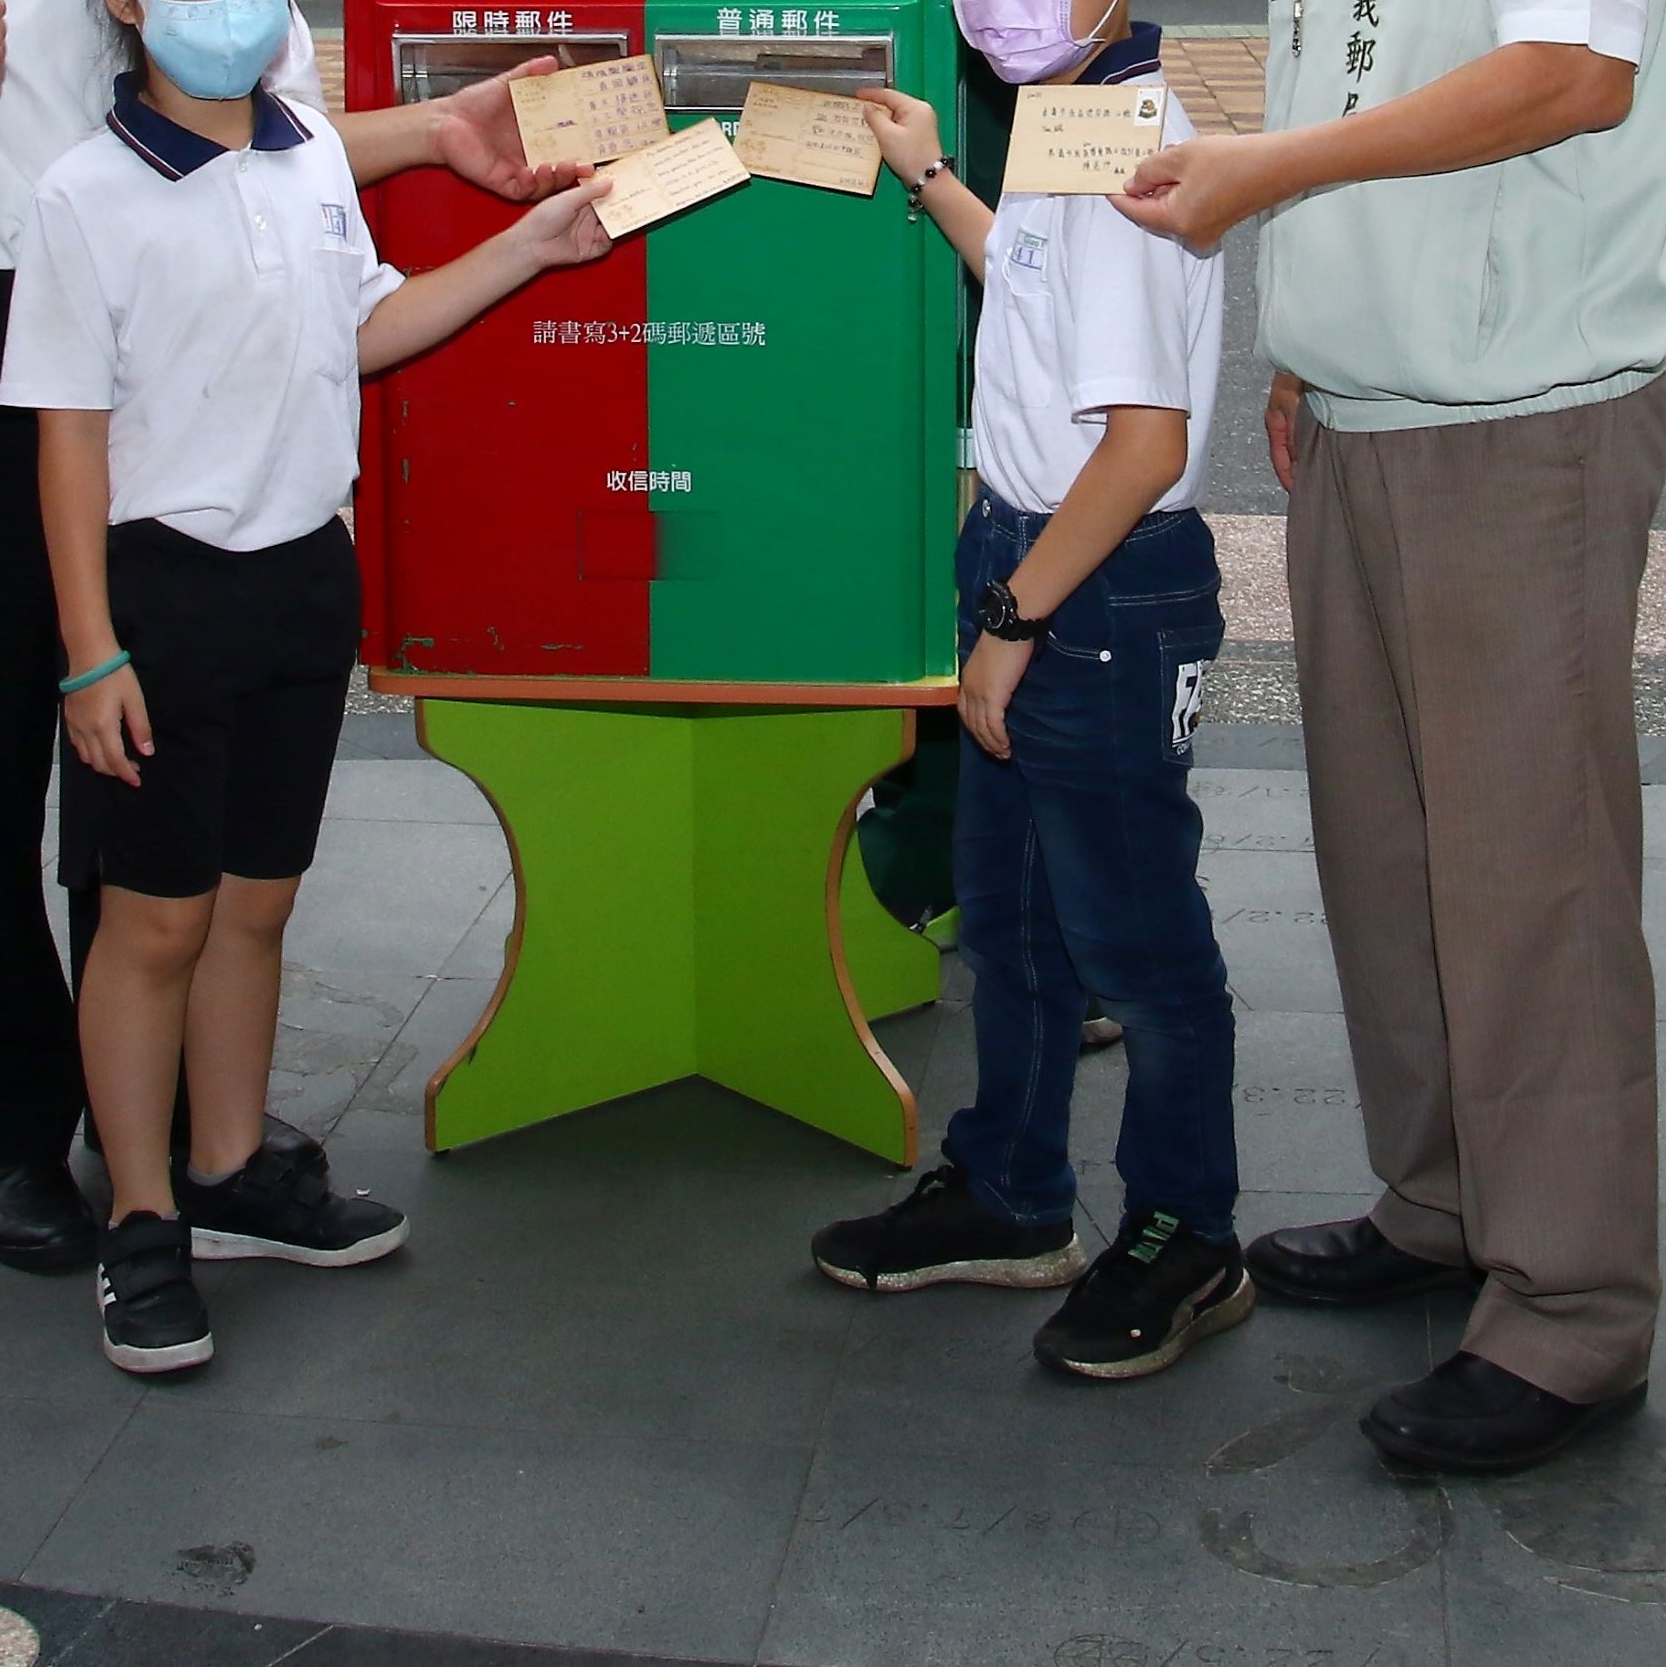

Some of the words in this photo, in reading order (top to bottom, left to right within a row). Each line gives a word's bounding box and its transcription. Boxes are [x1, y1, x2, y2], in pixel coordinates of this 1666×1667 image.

[452, 10, 574, 31] 限時郵件
[717, 7, 840, 31] 普通郵件
[532, 320, 766, 346] 請書寫3+2碼郵遞區號
[606, 470, 692, 493] 收信時間
